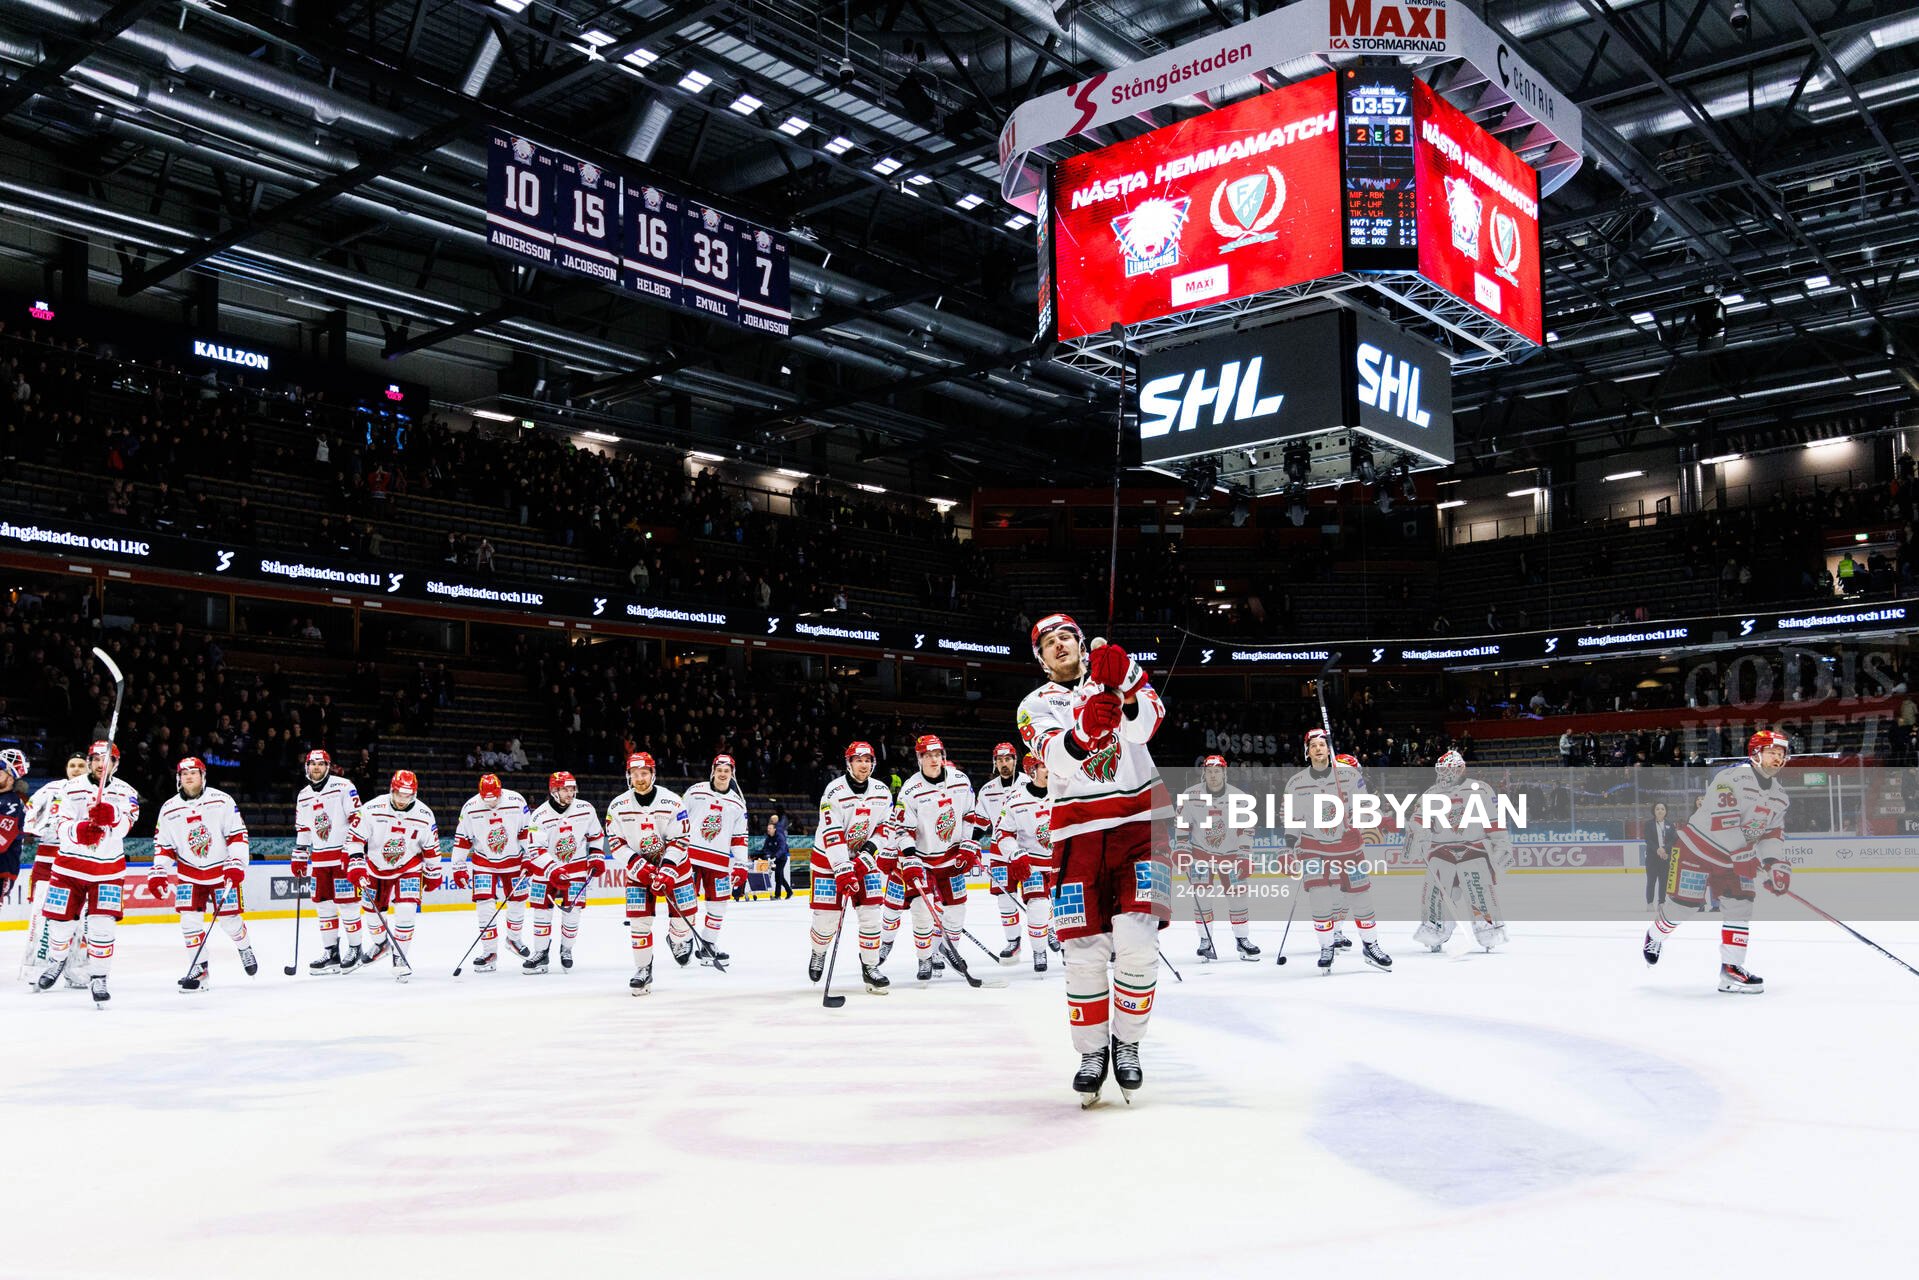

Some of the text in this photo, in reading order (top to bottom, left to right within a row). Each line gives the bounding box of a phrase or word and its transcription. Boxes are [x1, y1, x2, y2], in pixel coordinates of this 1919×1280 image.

[1330, 0, 1446, 39] MAXI
[1330, 38, 1446, 52] ICA STORMARKNAD
[1111, 41, 1252, 105] Stångåstaden
[1513, 67, 1554, 121] CENTRIA
[1352, 97, 1406, 114] 03:57
[1387, 117, 1411, 125] GUEST
[1356, 129, 1366, 141] 2
[1394, 129, 1404, 141] 3
[1154, 110, 1337, 184] HEMMAMATCH
[505, 165, 540, 217] 10
[1464, 152, 1538, 220] HEMMAMATCH
[573, 190, 606, 239] 15
[491, 230, 551, 262] ANDERSSON
[638, 213, 668, 260] 16
[694, 232, 728, 280] 33
[562, 254, 617, 281] JACOBSSON
[756, 256, 773, 296] 7
[636, 278, 672, 299] HELBER
[1185, 278, 1214, 292] MAXI
[696, 295, 728, 316] EMVALL
[743, 313, 789, 336] JOHANSSON
[194, 340, 269, 370] KALLZON
[1356, 342, 1430, 428] SHL
[1140, 356, 1284, 439] SHL
[91, 537, 119, 552] och
[121, 540, 150, 556] LHC
[260, 560, 345, 582] Stångåstaden
[346, 572, 370, 585] och
[426, 581, 544, 605] Stångåstaden och LHC
[626, 604, 727, 625] Stångåstaden och LHC
[1777, 608, 1905, 630] Stångåstaden och LHC
[795, 623, 880, 641] Stångåstaden och LHC
[1577, 628, 1688, 648] Stångåstaden och LHC
[938, 638, 1011, 655] Stångåstaden och LHC
[1138, 652, 1158, 661] LHC
[1232, 650, 1329, 661] Stångåstaden och LHC
[1402, 646, 1500, 660] Stångåstaden och LHC
[1684, 646, 1895, 712] GODIS
[1205, 728, 1278, 755] BOSSES
[1717, 792, 1737, 808] 36
[1548, 829, 1610, 843] krafter.
[1785, 846, 1814, 855] niska
[1859, 848, 1902, 856] ASKLING
